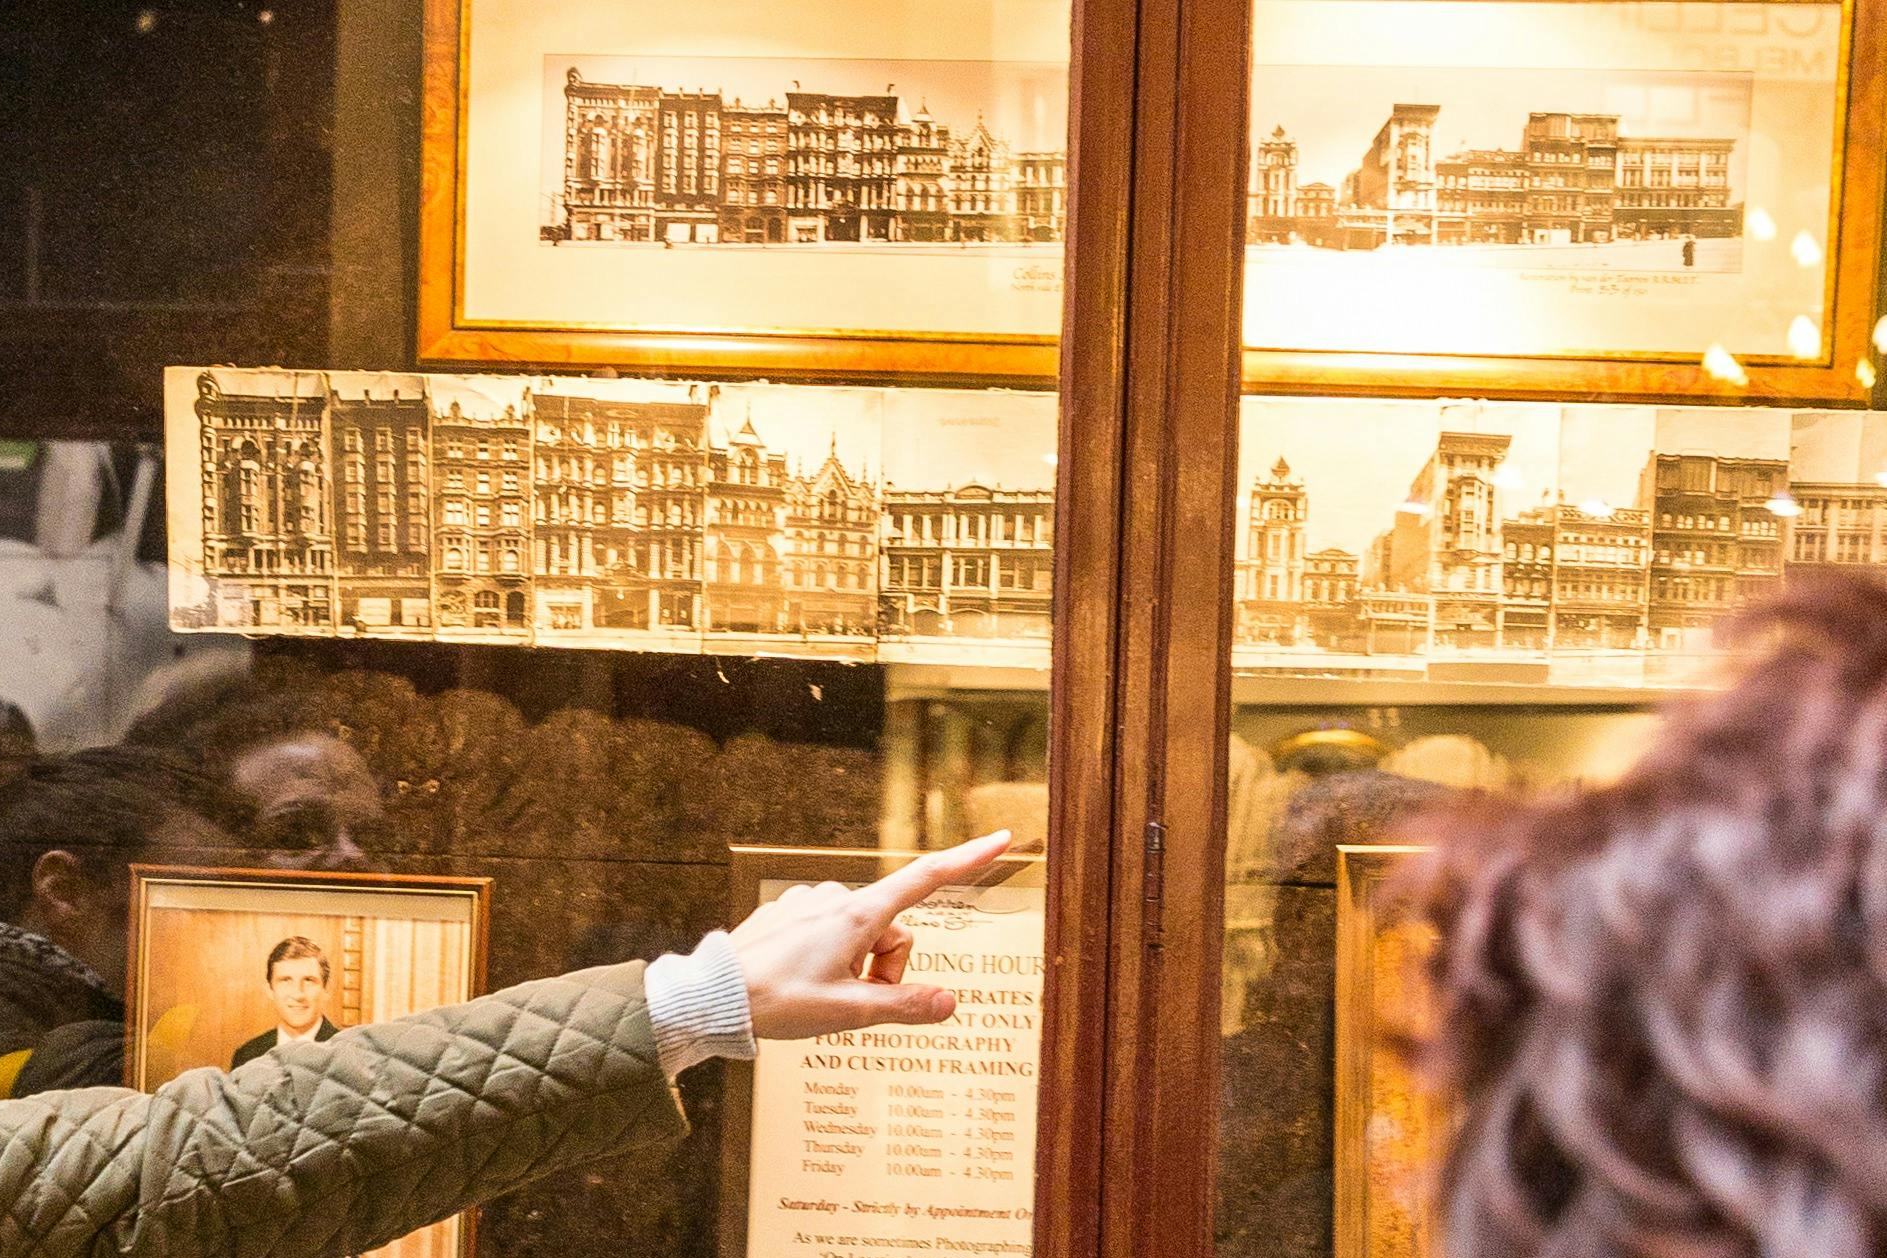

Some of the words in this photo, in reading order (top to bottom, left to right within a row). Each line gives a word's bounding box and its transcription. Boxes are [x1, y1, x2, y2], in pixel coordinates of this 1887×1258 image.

[982, 955, 1046, 976] HOUR
[982, 1013, 1036, 1030] ONLY
[815, 1032, 855, 1047] FOR
[861, 1033, 1016, 1053] PHOTOGRAPHY
[800, 1054, 842, 1069] AND
[847, 1056, 932, 1073] CUSTOM
[939, 1060, 1034, 1078] FRAMING
[804, 1081, 859, 1097] Monday
[803, 1101, 858, 1117] Tuesday
[803, 1120, 878, 1138] Wednesday
[803, 1140, 864, 1157] Thursday
[801, 1159, 846, 1176] Friday
[777, 1197, 839, 1215] Saturday
[852, 1200, 901, 1217] Strictly
[904, 1203, 920, 1218] by
[923, 1203, 1011, 1219] Appointment
[793, 1232, 812, 1244] As
[815, 1235, 834, 1245] we
[837, 1236, 858, 1246] are
[861, 1237, 931, 1249] sometimes
